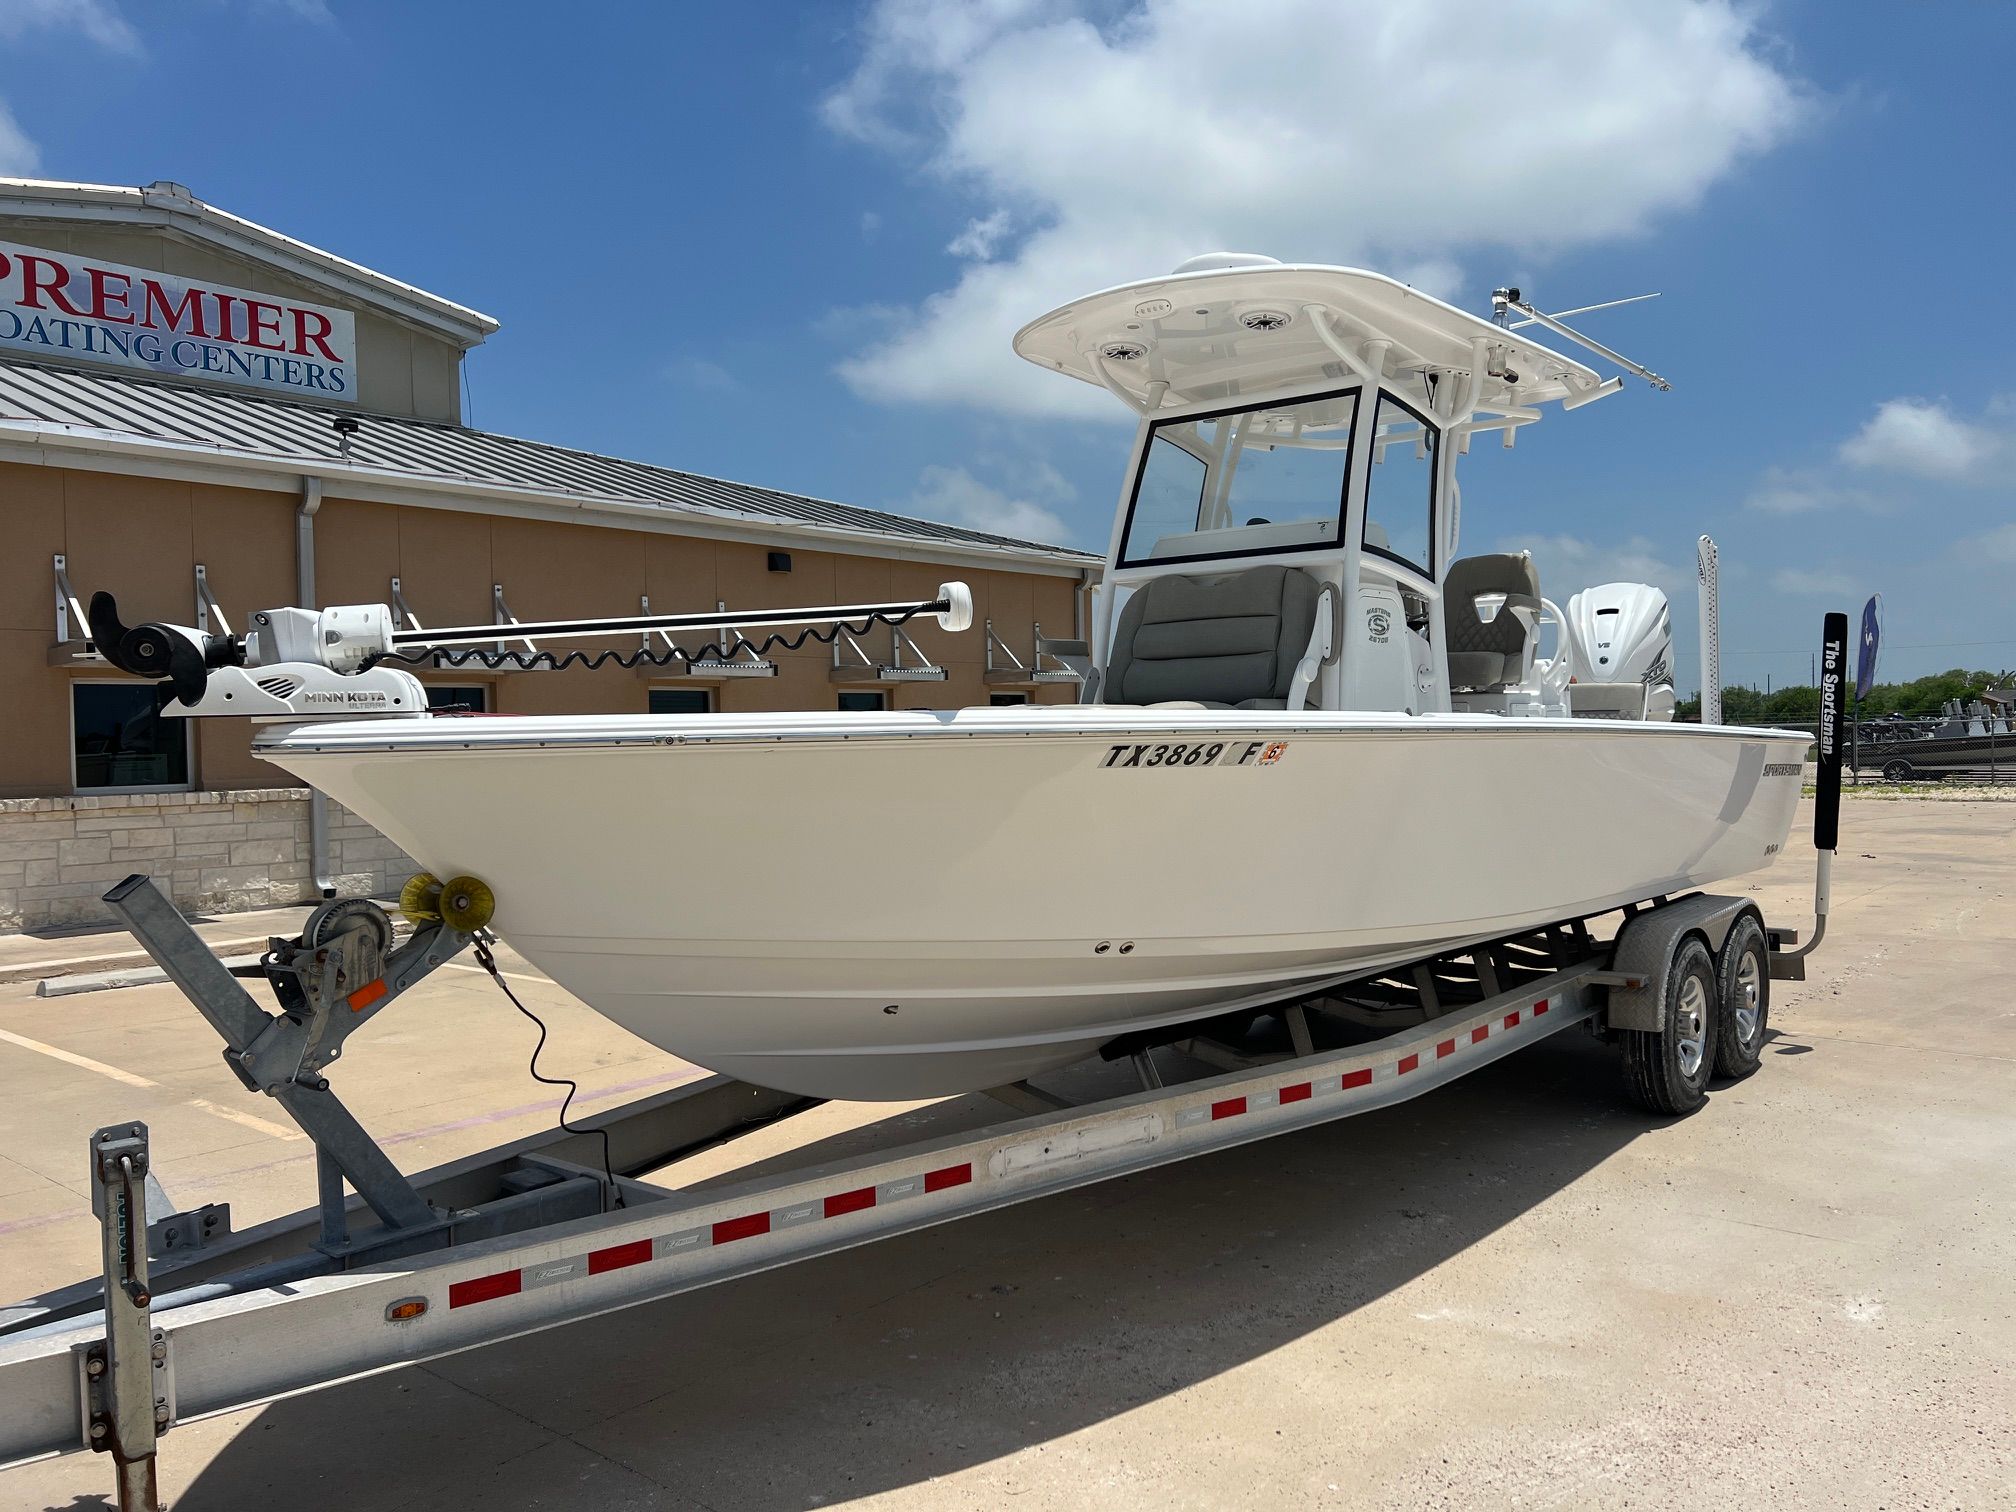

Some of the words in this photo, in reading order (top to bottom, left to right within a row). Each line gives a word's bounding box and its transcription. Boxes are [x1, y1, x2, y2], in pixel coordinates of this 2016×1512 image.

[0, 253, 344, 363] REMIER
[170, 339, 346, 393] CENTERS
[1825, 640, 1840, 669] The
[304, 692, 344, 703] MINN
[347, 692, 386, 702] KOTA
[1822, 673, 1839, 755] Sportsman
